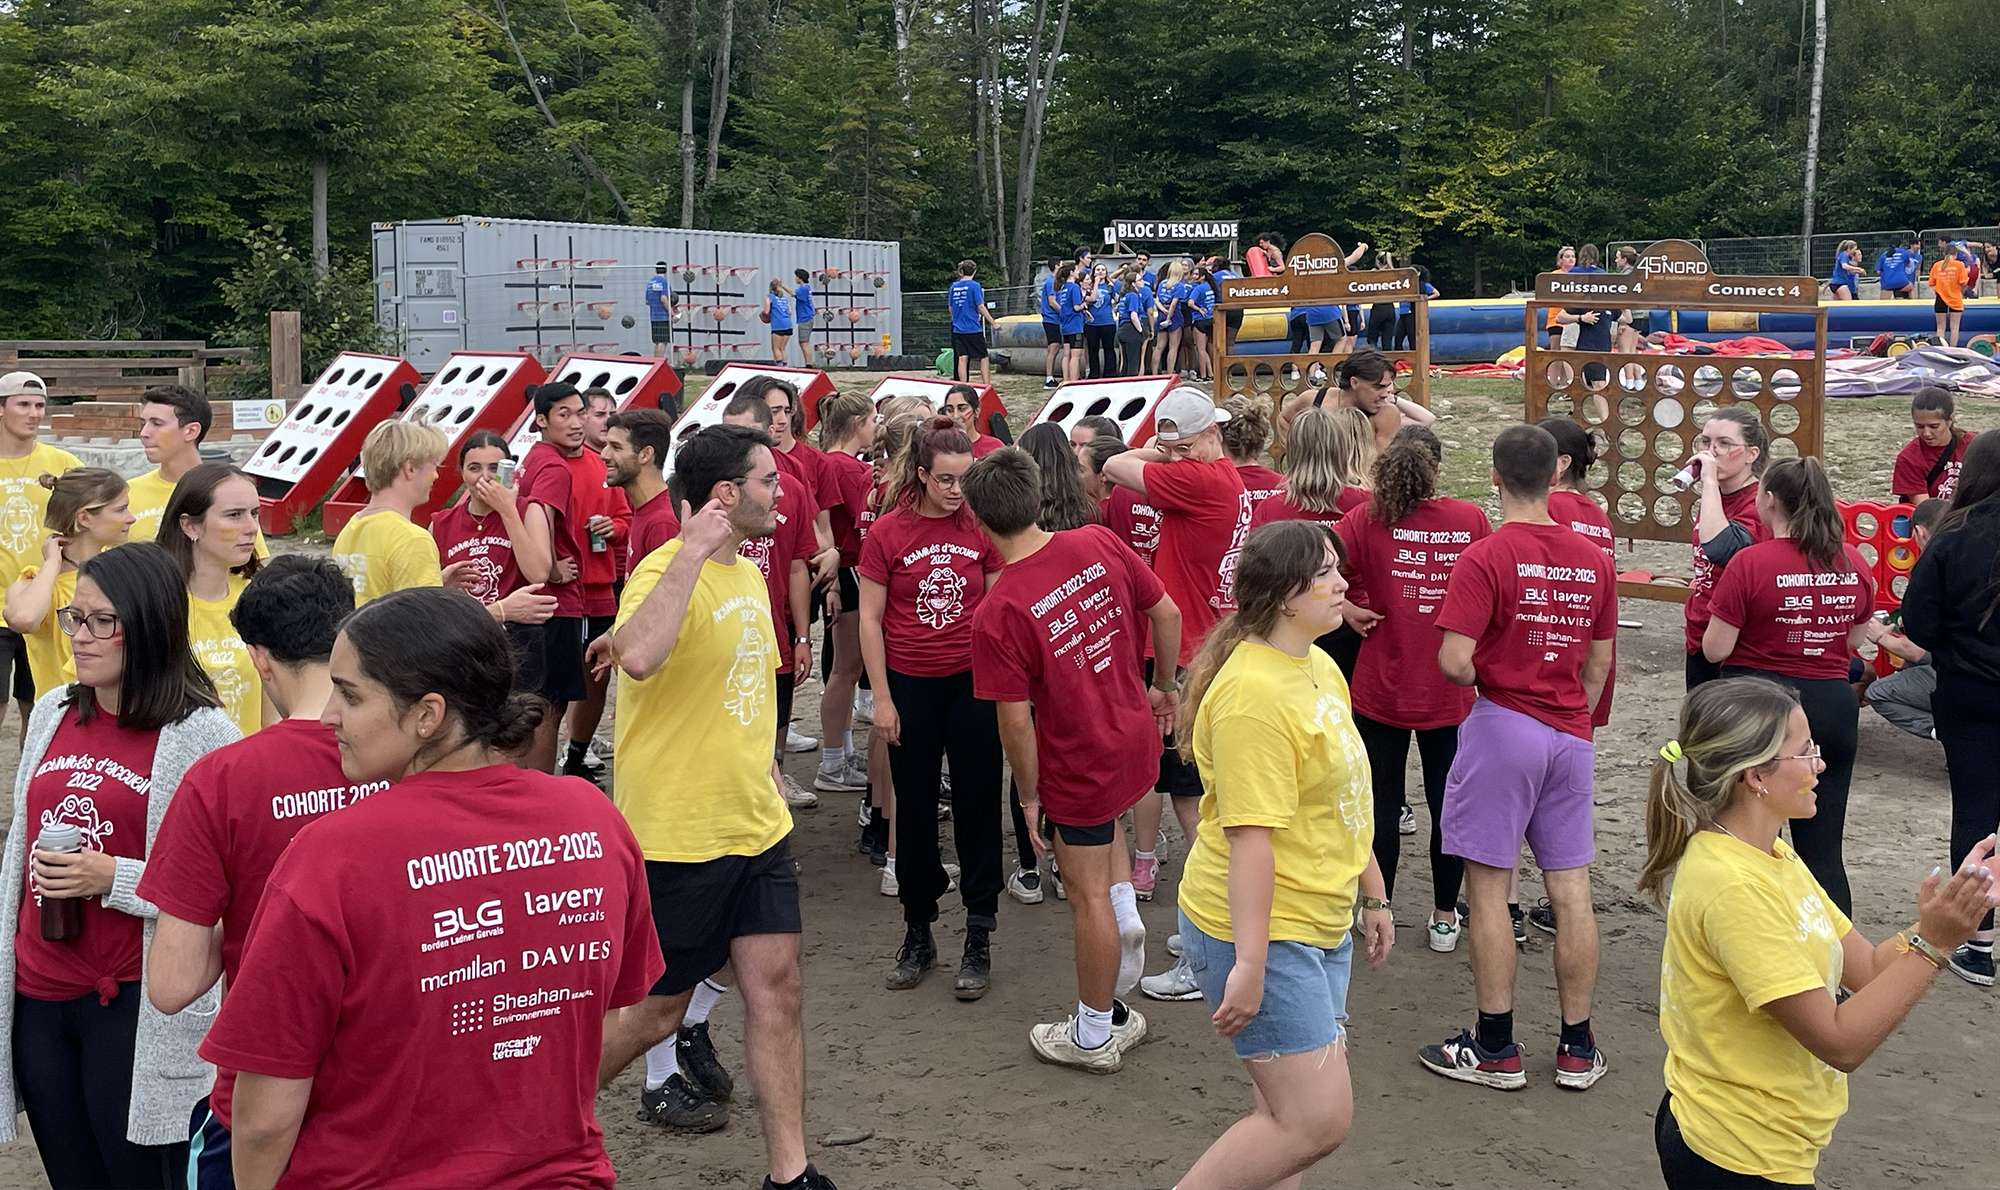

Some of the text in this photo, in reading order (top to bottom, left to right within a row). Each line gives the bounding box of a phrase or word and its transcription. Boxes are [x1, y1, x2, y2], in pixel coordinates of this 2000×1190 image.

[1118, 223, 1238, 238] BLOC D'ESCALADE
[1229, 285, 1289, 297] Puissance 4
[1348, 278, 1411, 293] Connect 4
[1550, 281, 1643, 294] Puissance 4
[1708, 283, 1801, 297] Connect 4
[518, 434, 536, 444] 200
[1393, 528, 1471, 544] COHORTE 2022-2025
[468, 545, 489, 556] 2022
[1398, 548, 1427, 562] BLG
[1434, 551, 1460, 561] laver
[930, 554, 951, 565] 2022
[1546, 567, 1596, 584] 2022-2025
[1776, 573, 1814, 588] COHORTE
[1030, 561, 1107, 619] COHORTE 2022-2025
[1553, 589, 1592, 604] lavery
[1784, 594, 1857, 607] BLG lavery
[1047, 608, 1078, 635] BLG
[1078, 586, 1110, 612] lavery
[1089, 606, 1122, 634] DAVES
[1550, 614, 1592, 628] DAVIES
[66, 771, 103, 791] 2022
[272, 786, 346, 820] COHORTE
[407, 831, 604, 890] COHORTE 2022-2025
[433, 887, 604, 938] BLG lavery
[558, 909, 605, 925] Avocats
[421, 926, 504, 953] Borden Ladner Gervais
[420, 940, 611, 992] mcmillan DAVIES
[492, 986, 571, 1013] Sheahan
[492, 1006, 561, 1026] Environnement
